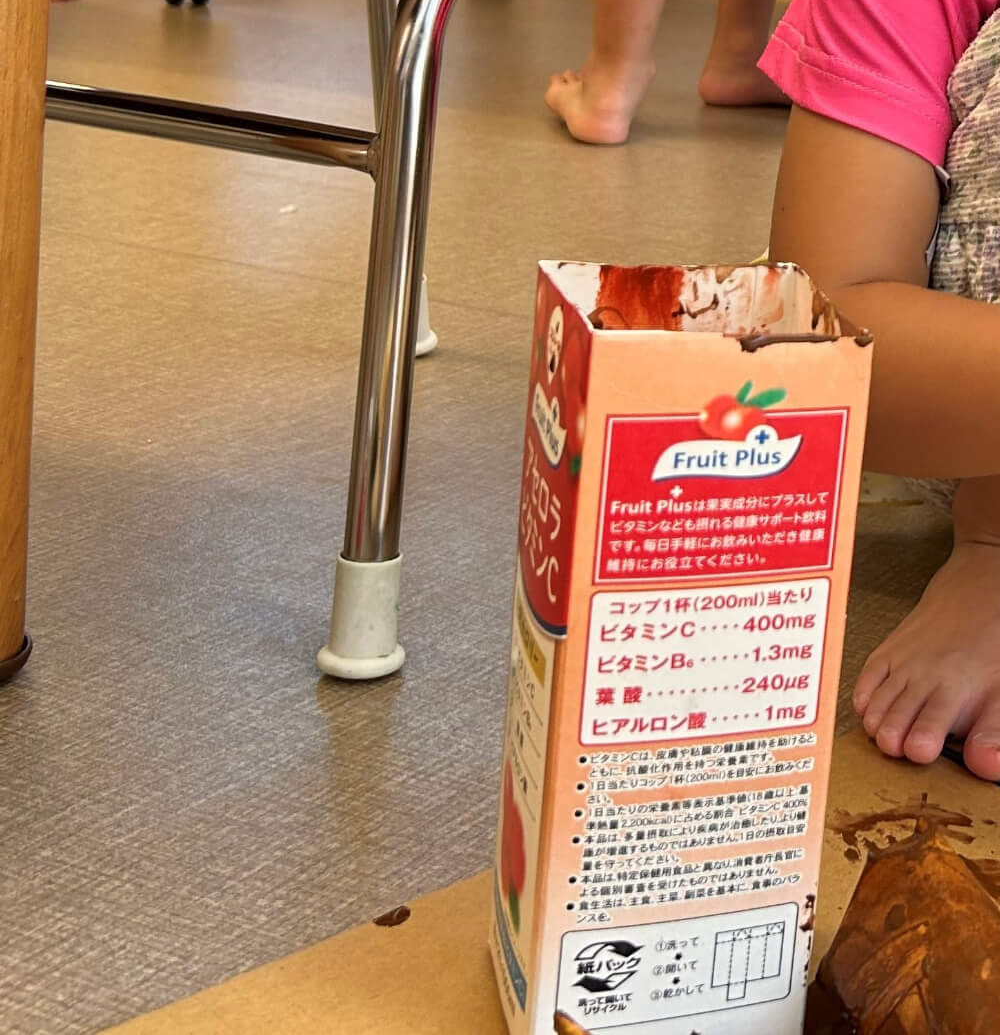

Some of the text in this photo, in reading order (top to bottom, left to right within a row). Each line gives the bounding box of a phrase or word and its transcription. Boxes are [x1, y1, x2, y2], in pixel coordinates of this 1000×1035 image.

[673, 448, 781, 469] Fruit Plus
[526, 436, 561, 540] アセロラ
[610, 500, 652, 514] Fruit
[610, 510, 827, 533] ビタミンなども摂れる健康サポート飲料
[606, 553, 767, 572] 維持にお役立てください。
[609, 587, 813, 614] コップ1杯(200ml)当たり
[743, 613, 816, 633] 400mg
[752, 643, 813, 662] 1.3mg
[765, 704, 807, 722] 1mg
[577, 958, 641, 974] 紙パック
[583, 1003, 627, 1015] リサイクル
